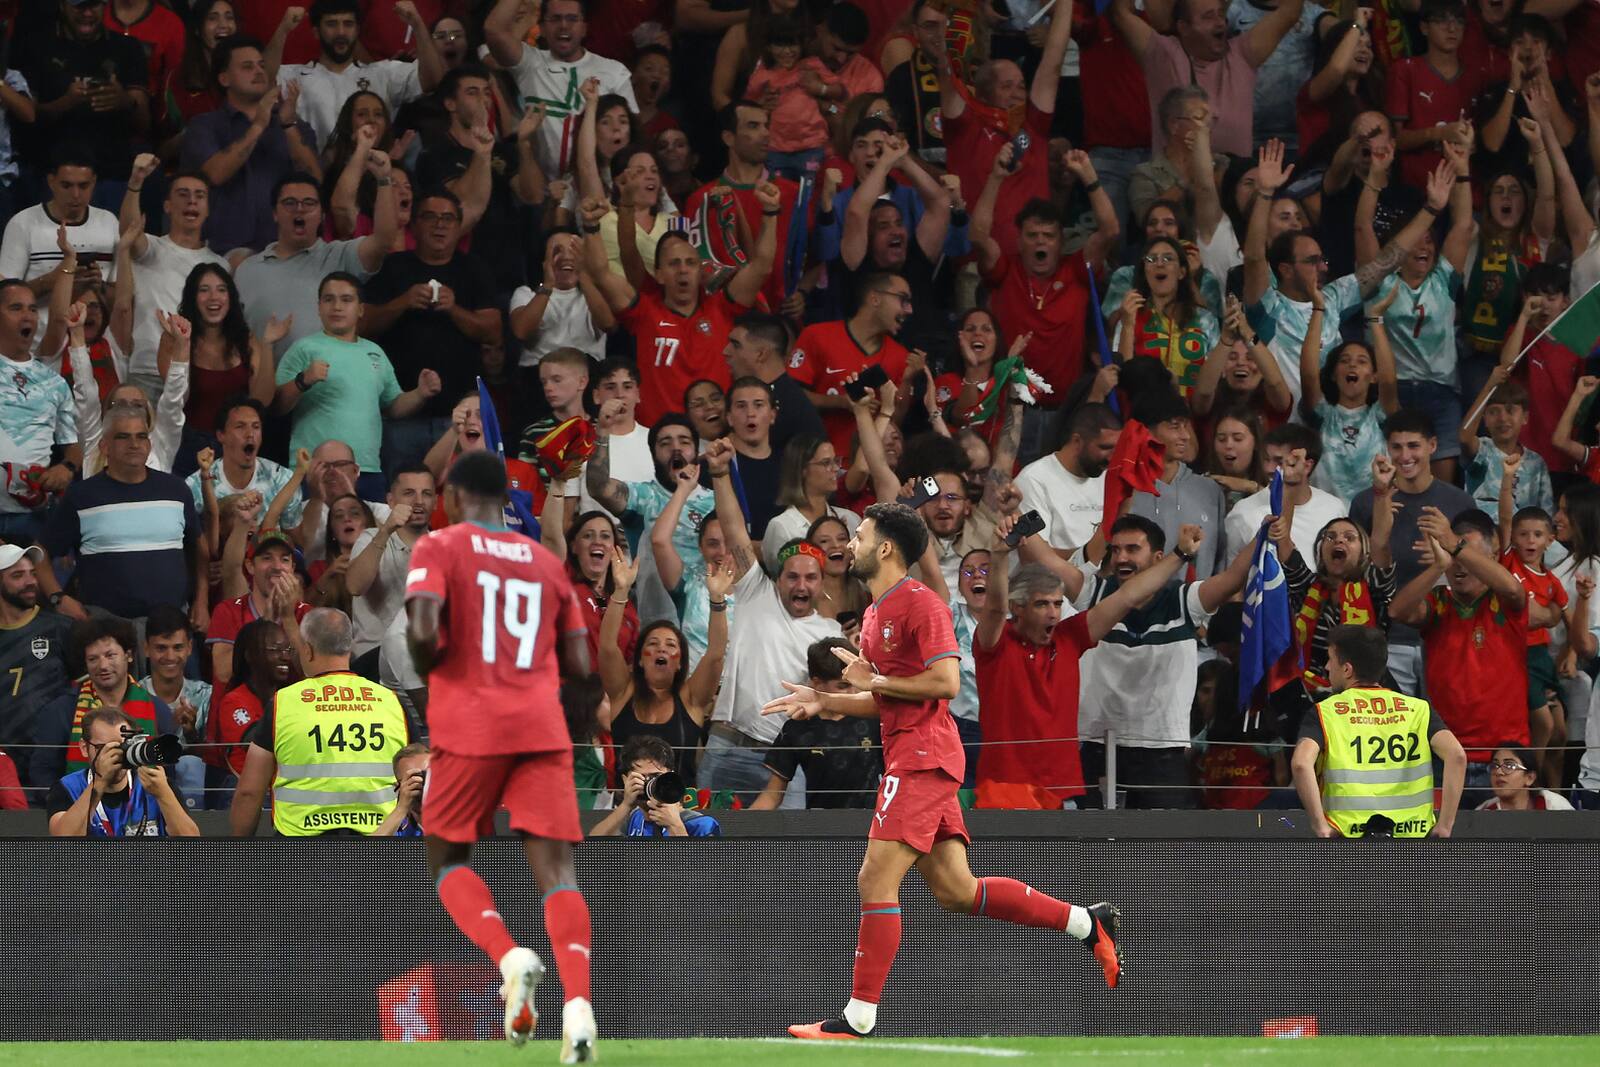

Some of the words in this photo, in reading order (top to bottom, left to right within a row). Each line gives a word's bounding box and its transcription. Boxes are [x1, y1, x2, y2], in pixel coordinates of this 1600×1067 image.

[654, 337, 680, 367] 77
[476, 570, 543, 669] 19
[8, 666, 24, 697] 7
[315, 704, 373, 712] SEGURANÇA
[308, 723, 385, 753] 1435
[1350, 732, 1421, 764] 1262
[881, 775, 900, 812] 9
[303, 813, 384, 828] ASSISTENTE
[1350, 820, 1427, 835] ASENTE
